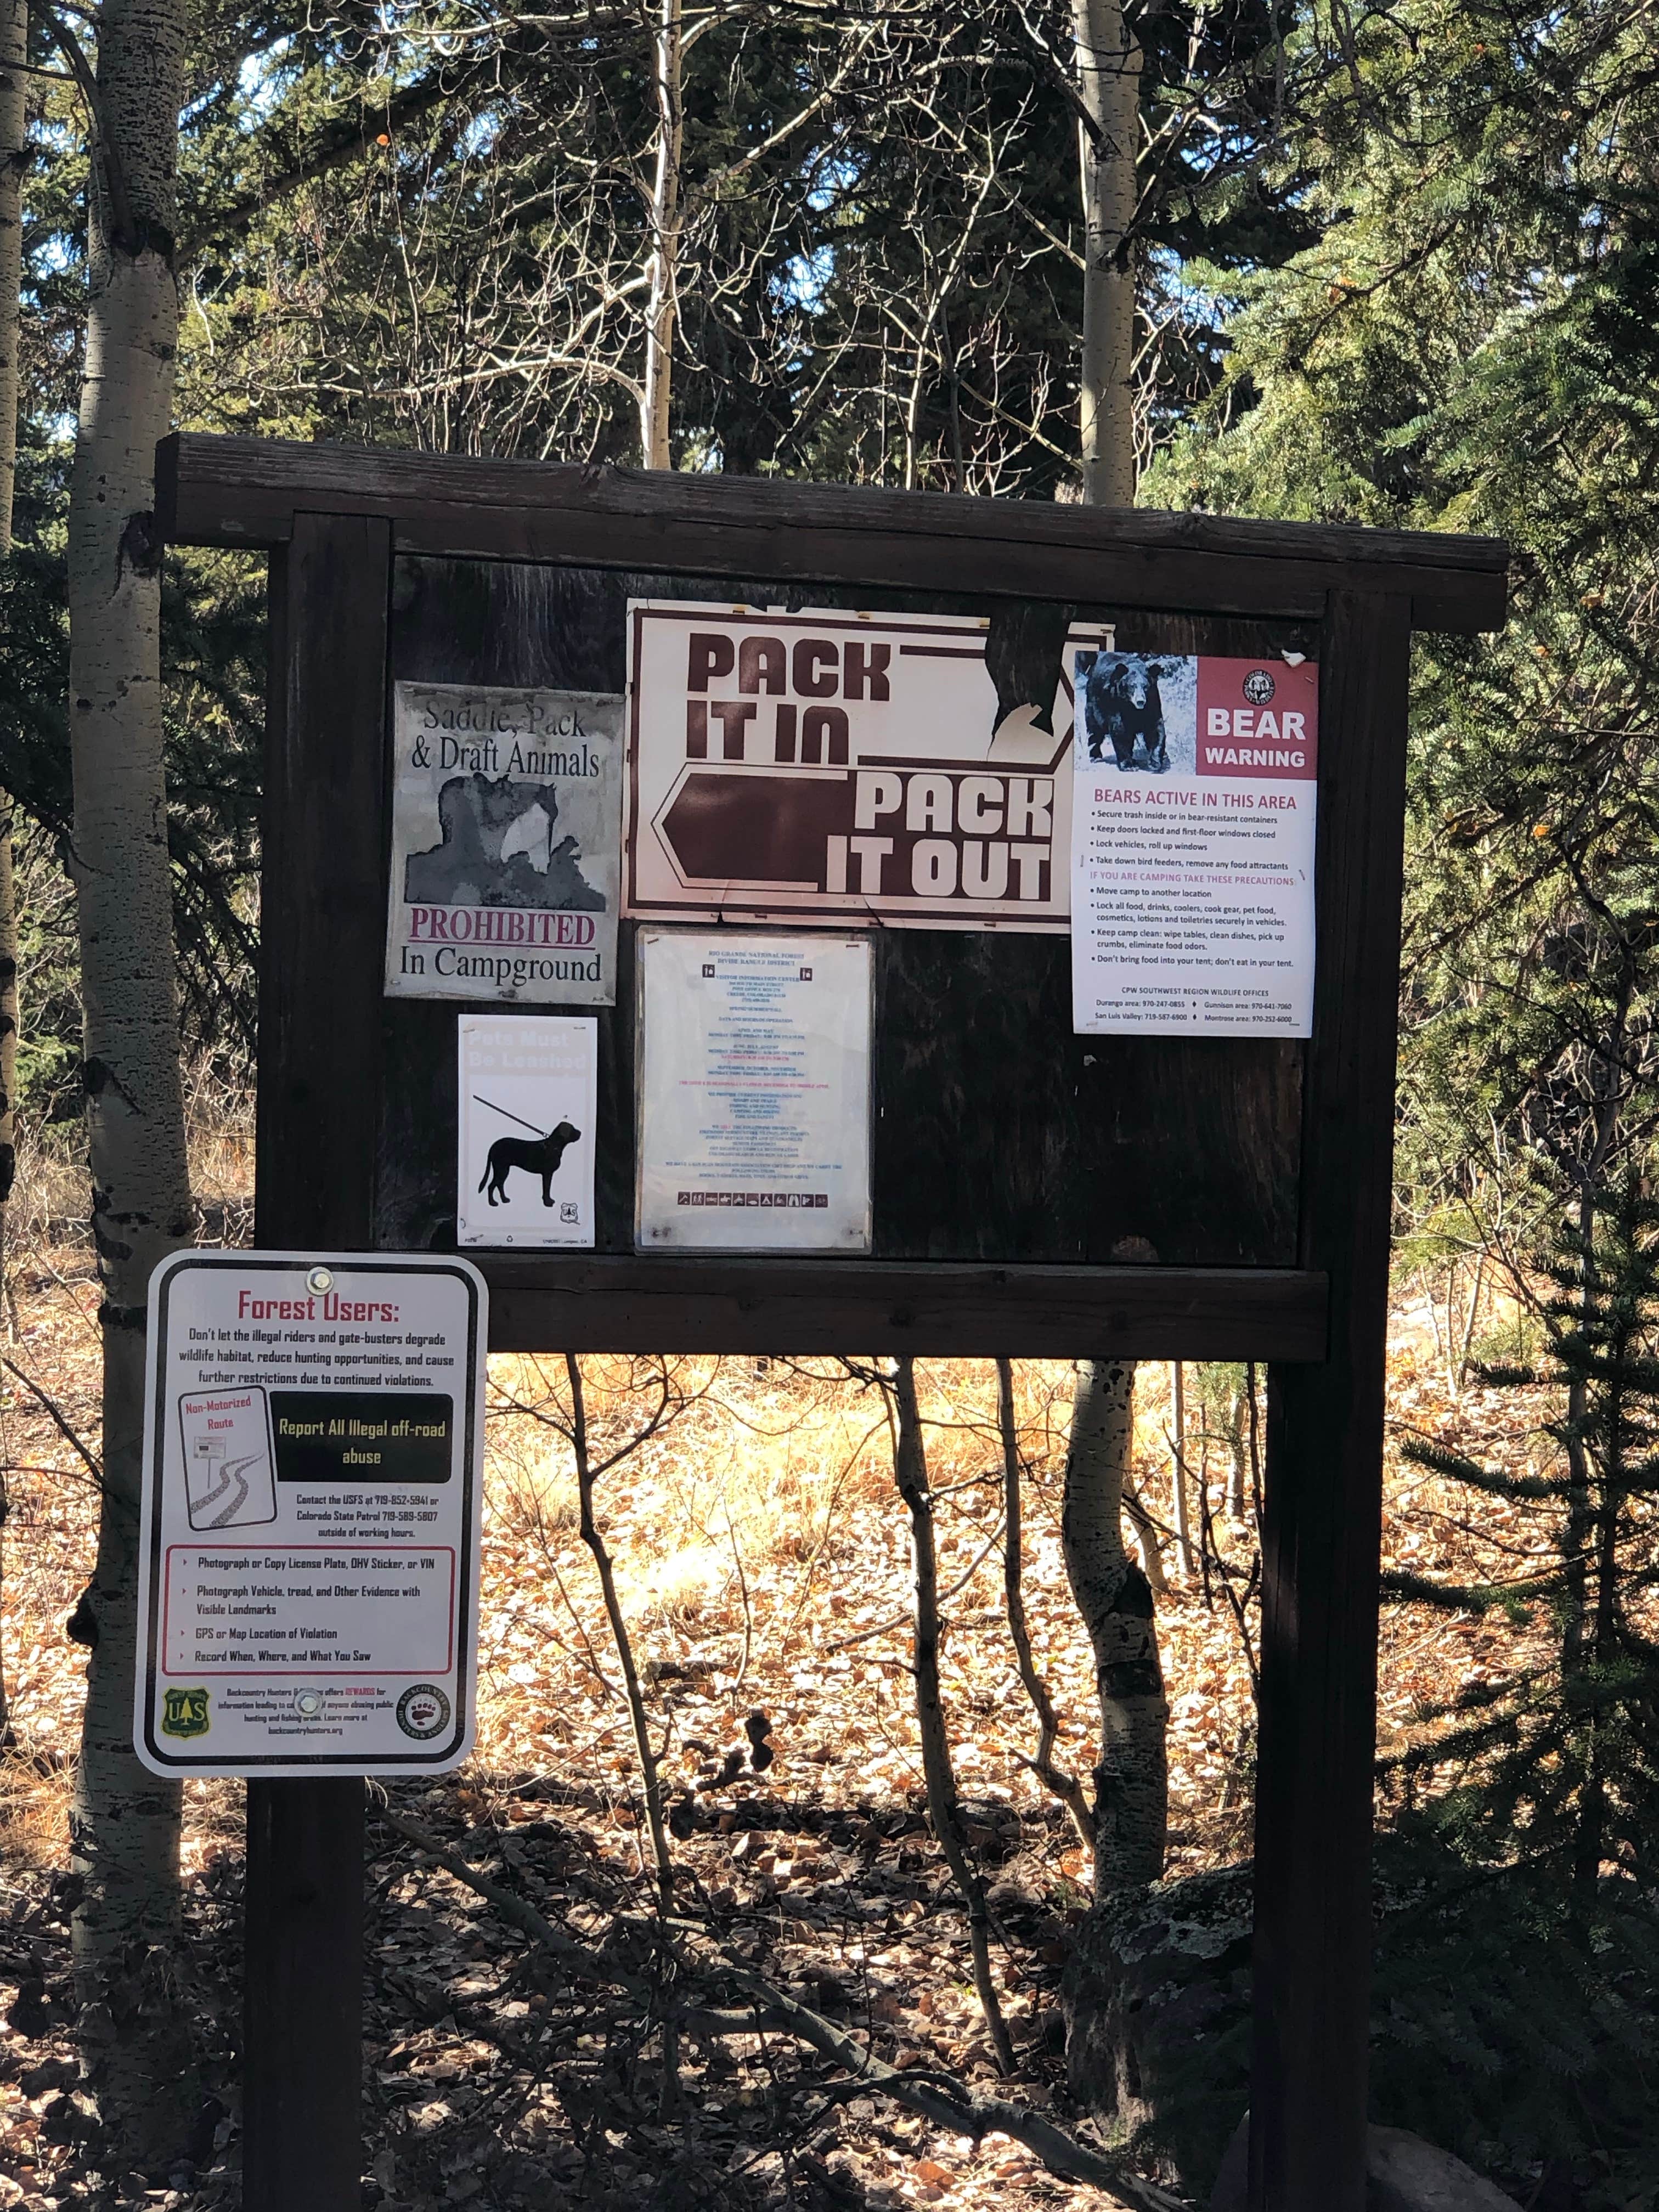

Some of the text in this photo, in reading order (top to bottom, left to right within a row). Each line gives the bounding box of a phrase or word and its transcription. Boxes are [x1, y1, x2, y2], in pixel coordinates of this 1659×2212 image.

[687, 633, 891, 701] PACK
[526, 702, 586, 737] Pack
[1207, 708, 1306, 740] BEAR
[686, 700, 757, 760] IT
[411, 735, 600, 777] & Draft Animals
[1205, 747, 1305, 768] WARNING
[855, 771, 1054, 837] PACK
[1095, 789, 1296, 809] BEARS ACTIVE IN THIS AREA
[1188, 814, 1238, 822] bear-resistant
[1097, 825, 1115, 834] Keep
[1182, 828, 1216, 836] first-floor
[1115, 840, 1147, 849] vehicles,
[827, 835, 1051, 900] IT OUT
[1154, 858, 1184, 867] feeders,
[1140, 873, 1181, 882] CAMPING
[1207, 875, 1233, 884] THESE
[411, 907, 595, 945] PROHIBITED
[400, 946, 601, 986] In Campground
[1120, 956, 1139, 964] bring
[239, 1290, 399, 1322] Forest Users:
[190, 1328, 445, 1347] Don't let the illegal riders and gate-busters degrade
[179, 1349, 454, 1366] wildlife habitat, reduce hunting opportunities, and cause
[199, 1370, 433, 1386] further restrictions due to continued violations.
[185, 1397, 251, 1414] Non-Motorized
[207, 1419, 234, 1430] Route
[280, 1419, 445, 1439] Report All Illegal off-road
[343, 1449, 381, 1464] abuse
[297, 1494, 326, 1504] Contact
[329, 1495, 341, 1504] the
[343, 1494, 363, 1504] USFS
[365, 1497, 373, 1505] at
[297, 1511, 332, 1520] Colorado
[334, 1511, 354, 1521] State
[357, 1511, 380, 1521] Patrol
[199, 1557, 250, 1570] Photograph
[265, 1558, 286, 1570] Copy
[289, 1558, 321, 1568] License
[324, 1558, 348, 1570] Plate,
[351, 1558, 369, 1568] OHV
[371, 1558, 405, 1569] Sticker,
[420, 1559, 435, 1568] VIN
[198, 1585, 249, 1598] Photograph
[316, 1585, 332, 1596] and
[335, 1585, 359, 1596] Other
[362, 1586, 400, 1596] Evidence
[402, 1586, 420, 1596] with
[197, 1604, 276, 1615] Visible Landmarks
[196, 1628, 213, 1639] GPS
[229, 1628, 247, 1641] Map
[249, 1628, 286, 1639] Location
[289, 1628, 298, 1639] of
[300, 1628, 337, 1639] Violation
[195, 1651, 227, 1661] Record
[258, 1650, 289, 1662] Where,
[291, 1650, 308, 1661] and
[310, 1650, 332, 1661] What
[335, 1650, 351, 1661] You
[353, 1651, 371, 1661] Saw
